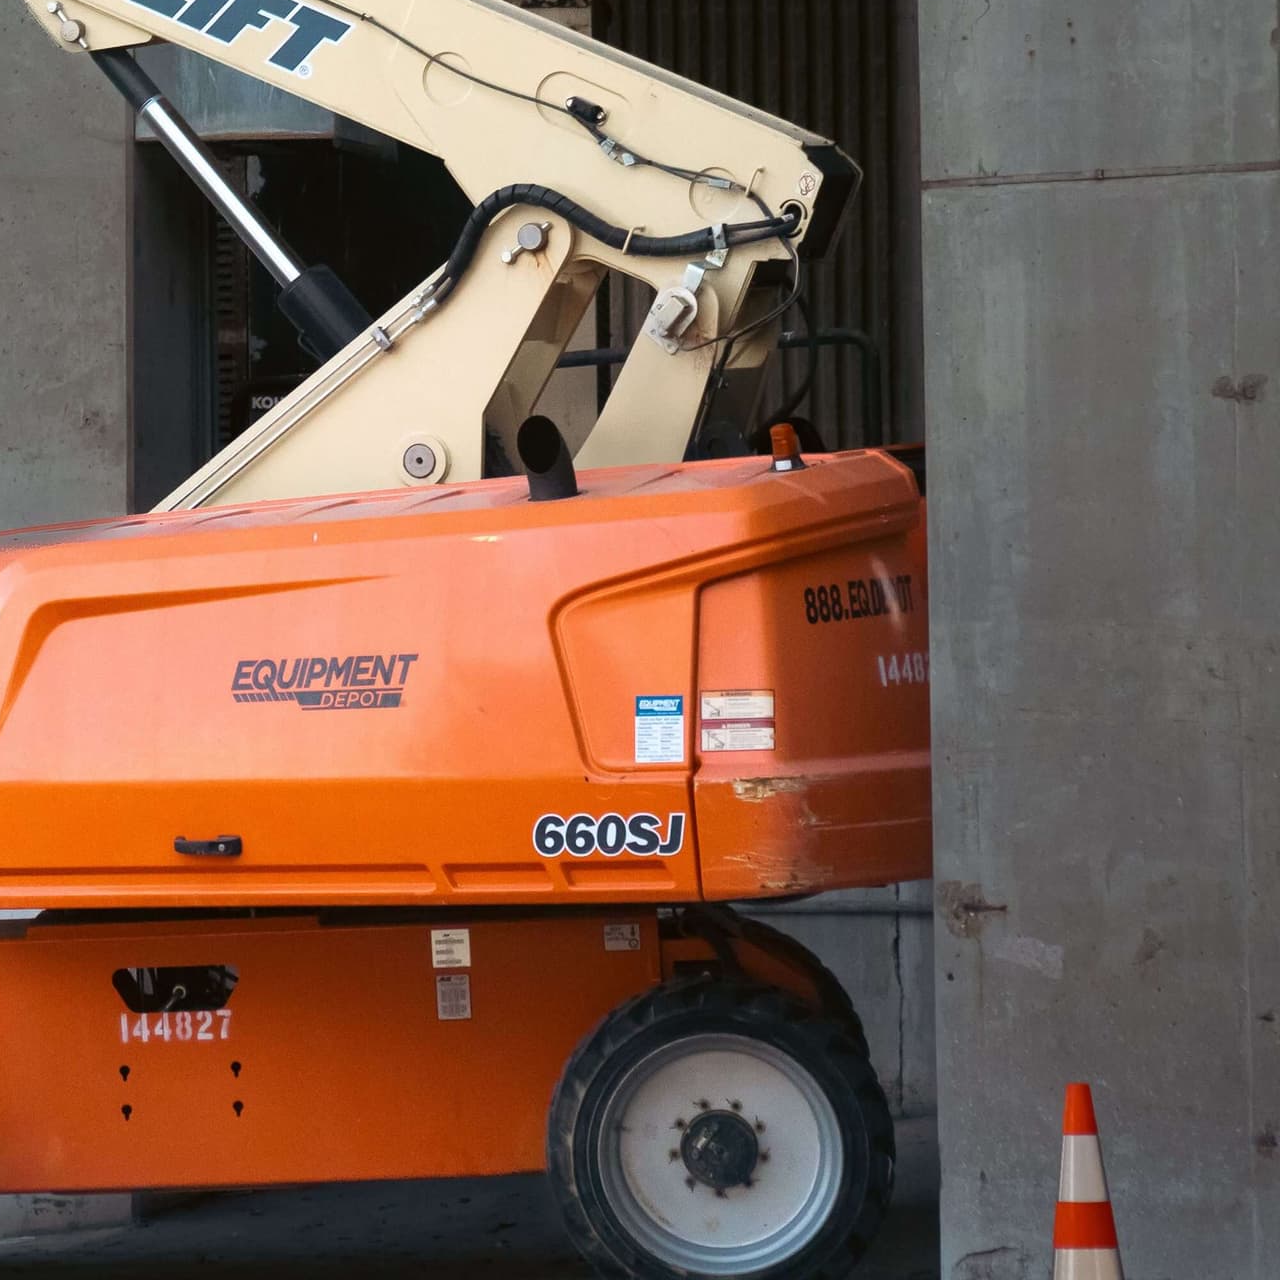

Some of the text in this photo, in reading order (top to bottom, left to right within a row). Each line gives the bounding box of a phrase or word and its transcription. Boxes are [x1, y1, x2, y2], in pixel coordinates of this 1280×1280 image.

[231, 653, 419, 697] EQUIPMENT
[877, 652, 929, 688] 1448
[320, 691, 384, 708] DEPOT
[533, 813, 685, 857] 660SJ
[120, 1009, 232, 1043] 144827
